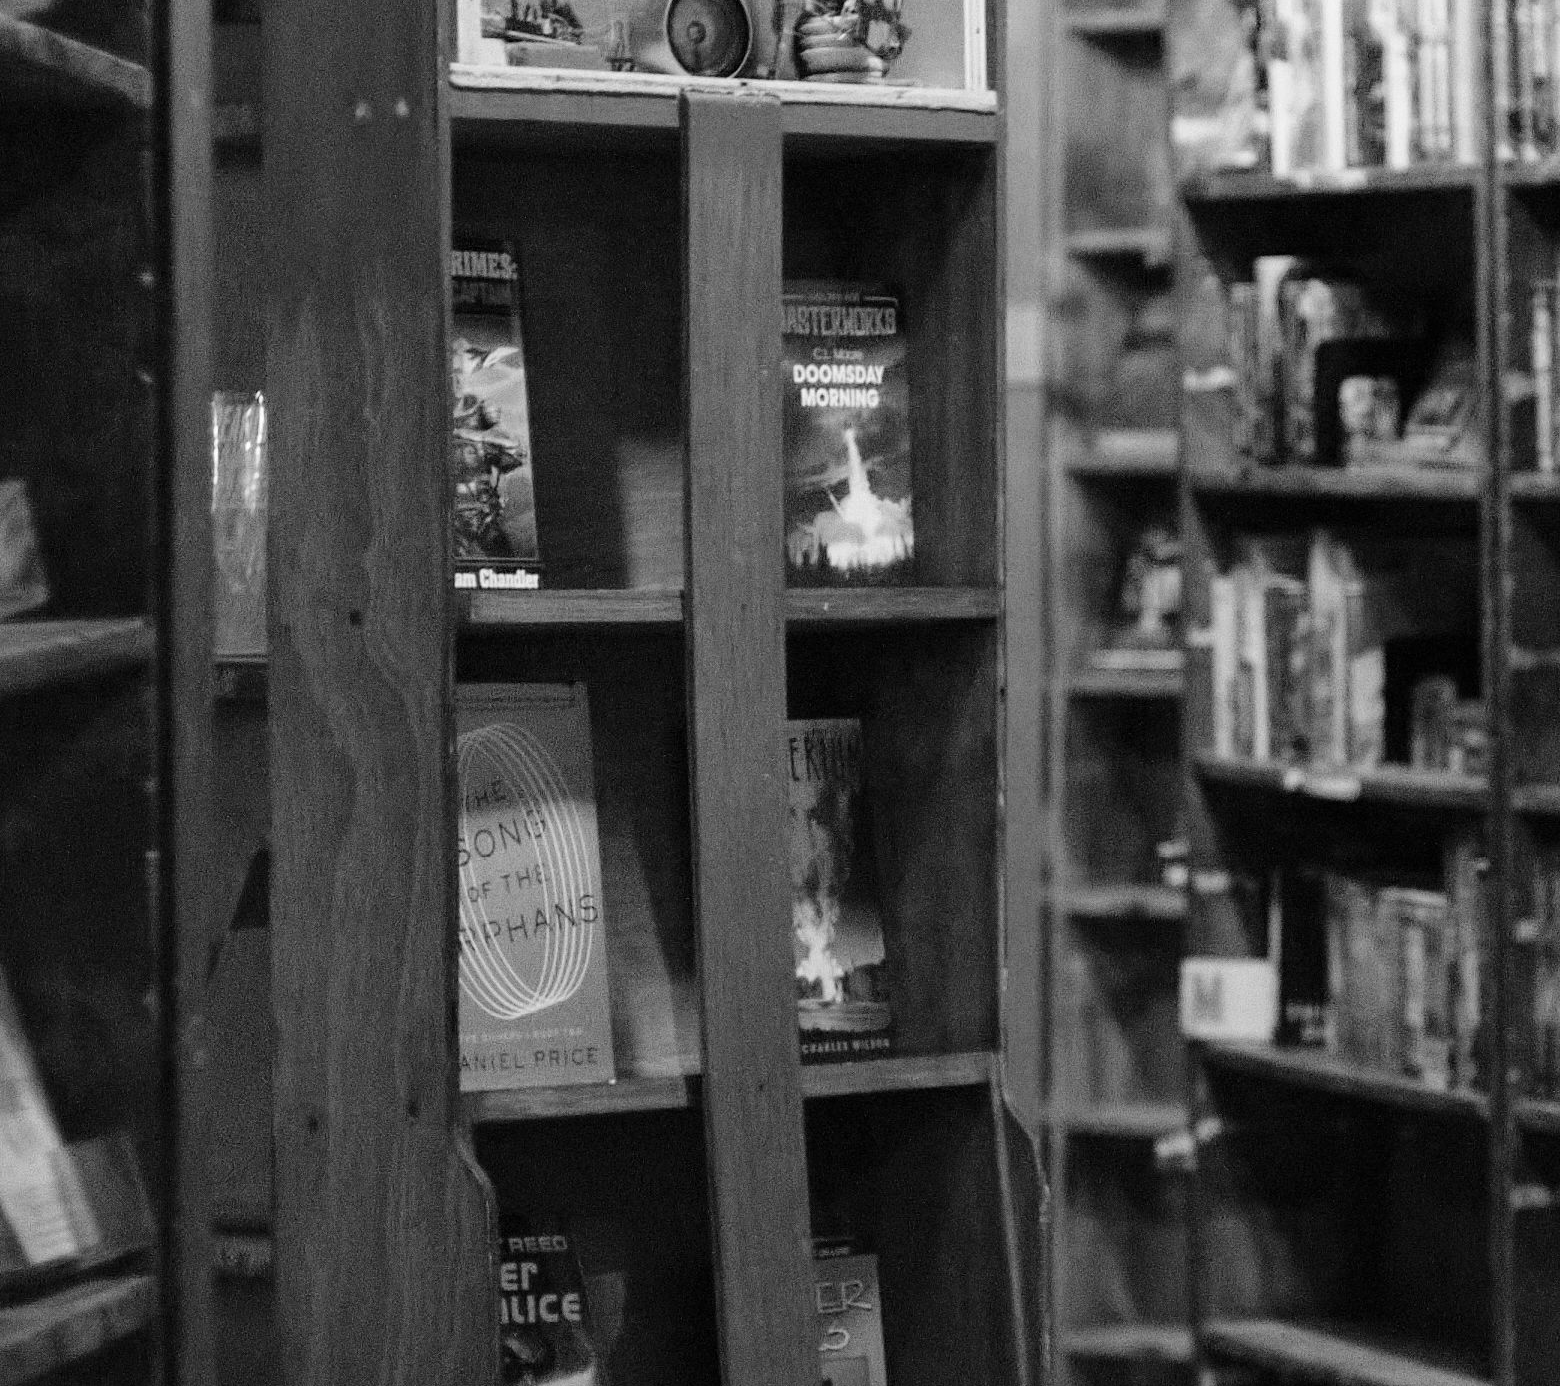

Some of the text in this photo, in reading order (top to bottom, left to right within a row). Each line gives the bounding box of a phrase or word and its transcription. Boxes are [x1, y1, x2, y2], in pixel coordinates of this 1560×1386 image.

[792, 364, 885, 384] DOOMSDAY
[800, 387, 880, 409] MORNING
[479, 568, 539, 589] Chandler
[468, 866, 549, 904] OF THE
[534, 1047, 599, 1067] PRICE
[508, 1235, 569, 1253] REED
